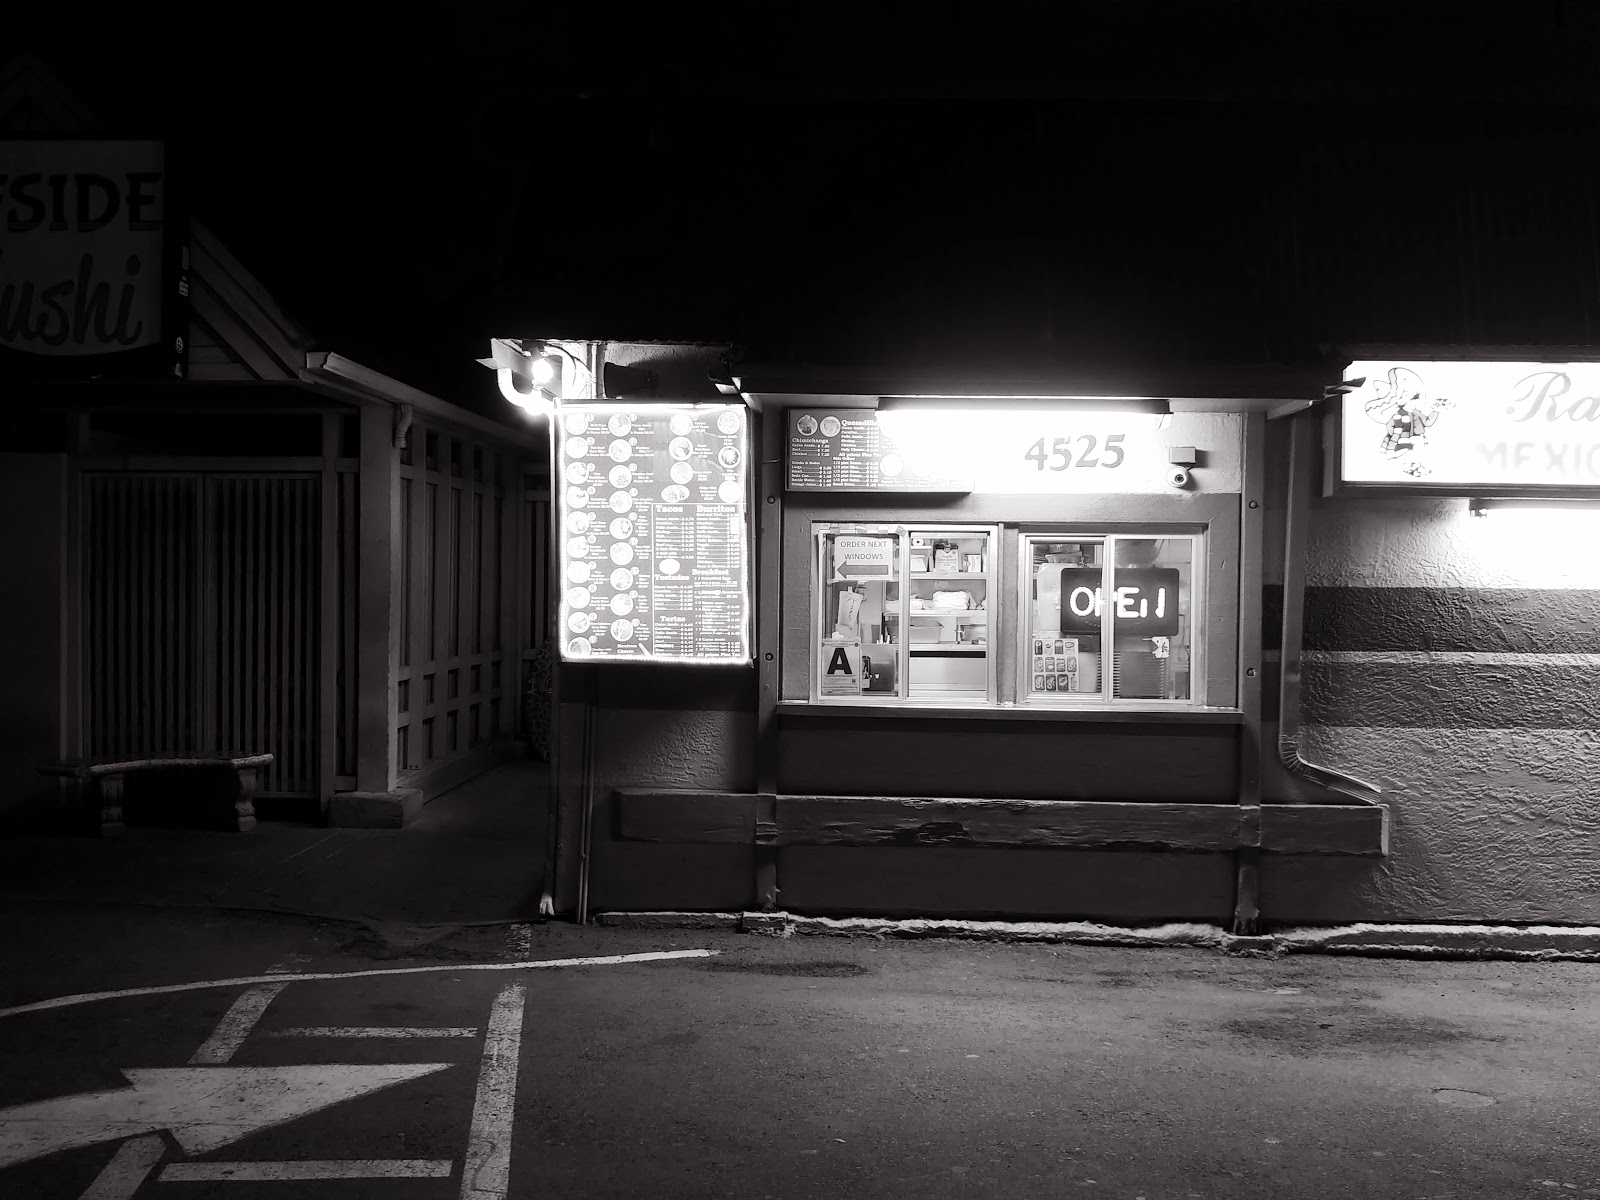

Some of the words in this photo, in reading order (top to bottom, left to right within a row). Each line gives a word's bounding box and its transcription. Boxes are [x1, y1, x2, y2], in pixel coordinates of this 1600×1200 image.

[0, 173, 163, 231] SIDE
[0, 253, 142, 346] ushi
[1024, 434, 1126, 471] 4525
[827, 647, 853, 674] A
